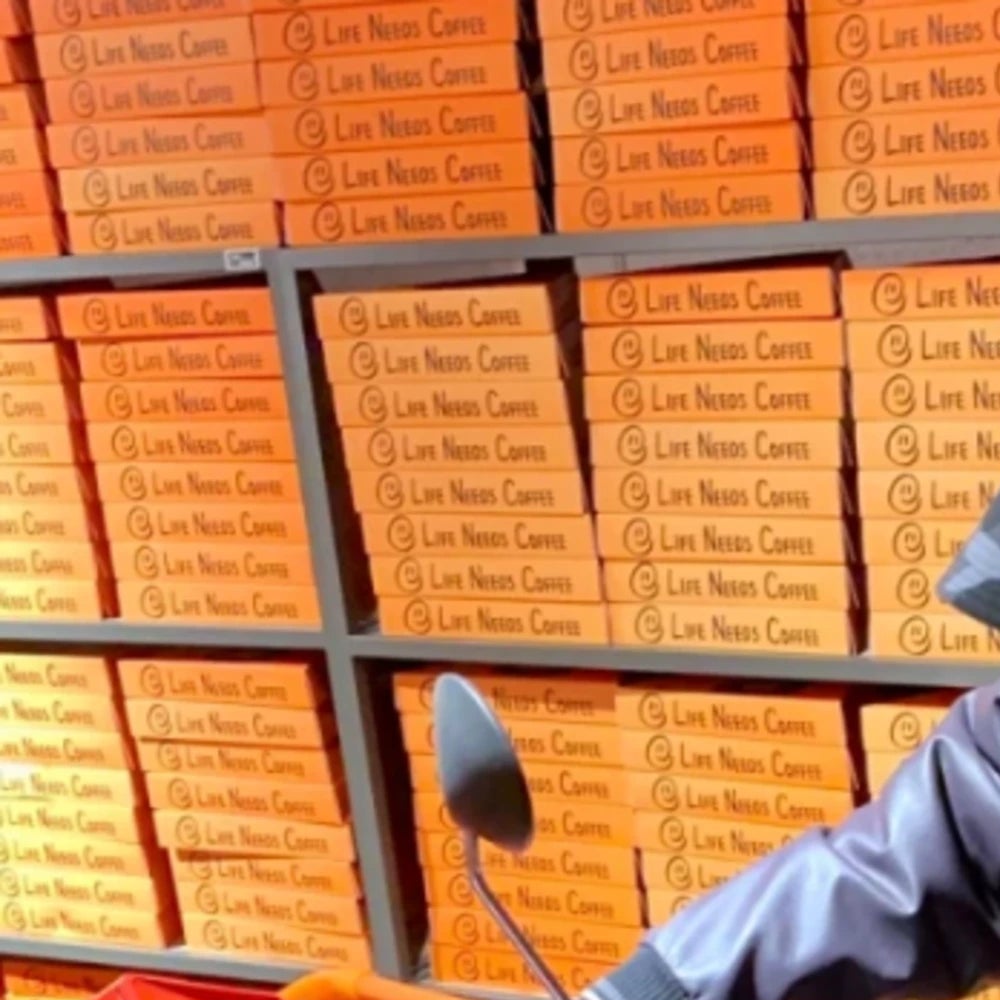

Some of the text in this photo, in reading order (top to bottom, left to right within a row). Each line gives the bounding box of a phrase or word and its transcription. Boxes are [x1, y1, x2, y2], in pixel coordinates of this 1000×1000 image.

[323, 6, 487, 46] LIFE NEEDS COFFEE
[878, 18, 920, 48] LIFE
[924, 14, 986, 45] NEEDS
[605, 34, 759, 72] LIFE NEEDS COFFEE
[326, 54, 488, 90] LIFE NEEDS COFFEE
[881, 69, 922, 100] LIFE
[927, 65, 989, 97] NEEDS
[334, 102, 496, 138] LIFE NEEDS COFFEE
[608, 86, 760, 122] LIFE NEEDS COFFEE
[616, 135, 769, 170] LIFE NEEDS COFFEE
[884, 123, 925, 154] LIFE
[930, 120, 992, 152] NEEDS
[341, 151, 502, 186] LIFE NEEDS COFFEE
[618, 185, 773, 220] LIFE NEEDS COFFEE
[885, 175, 926, 206] LIFE
[931, 172, 993, 204] NEEDS
[351, 198, 508, 231] LIFE NEEDS COFFEE
[646, 279, 803, 312] LIFE NEEDS COFFEE
[916, 277, 957, 308] LIFE
[376, 297, 521, 329] LIFE NEEDS COFFEE
[384, 343, 530, 373] LIFE NEEDS COFFEE
[652, 328, 814, 362] LIFE NEEDS COFFEE
[921, 329, 961, 360] LIFE
[394, 388, 539, 417] LIFE NEEDS COFFEE
[653, 378, 811, 410] LIFE NEEDS COFFEE
[925, 380, 964, 411] LIFE
[403, 432, 547, 460] LIFE NEEDS COFFEE
[654, 428, 810, 459] LIFE NEEDS COFFEE
[928, 430, 968, 461] LIFE
[411, 476, 554, 505] LIFE NEEDS COFFEE
[656, 476, 810, 507] LIFE NEEDS COFFEE
[930, 480, 969, 510] LIFE
[421, 519, 566, 548] LIFE NEEDS COFFEE
[660, 523, 814, 555] LIFE NEEDS COFFEE
[429, 562, 573, 592] LIFE NEEDS COFFEE
[666, 569, 819, 601] LIFE NEEDS COFFEE
[437, 606, 580, 635] LIFE NEEDS COFFEE
[670, 612, 819, 646] LIFE NEEDS COFFEE
[942, 621, 978, 653] LIFE
[493, 687, 594, 715] NEEDS COFFEE
[672, 701, 816, 737] LIFE NEEDS COFFEE
[551, 729, 603, 757] COFFEE
[680, 741, 822, 780] LIFE NEEDS COFFEE
[560, 769, 609, 798] COFFEE
[686, 783, 825, 822] LIFE NEEDS COFFEE
[563, 810, 611, 836] COFFEE
[692, 824, 724, 850] LIFE
[561, 850, 609, 879] COFFEE
[517, 884, 614, 918] NEEDS COFFEE
